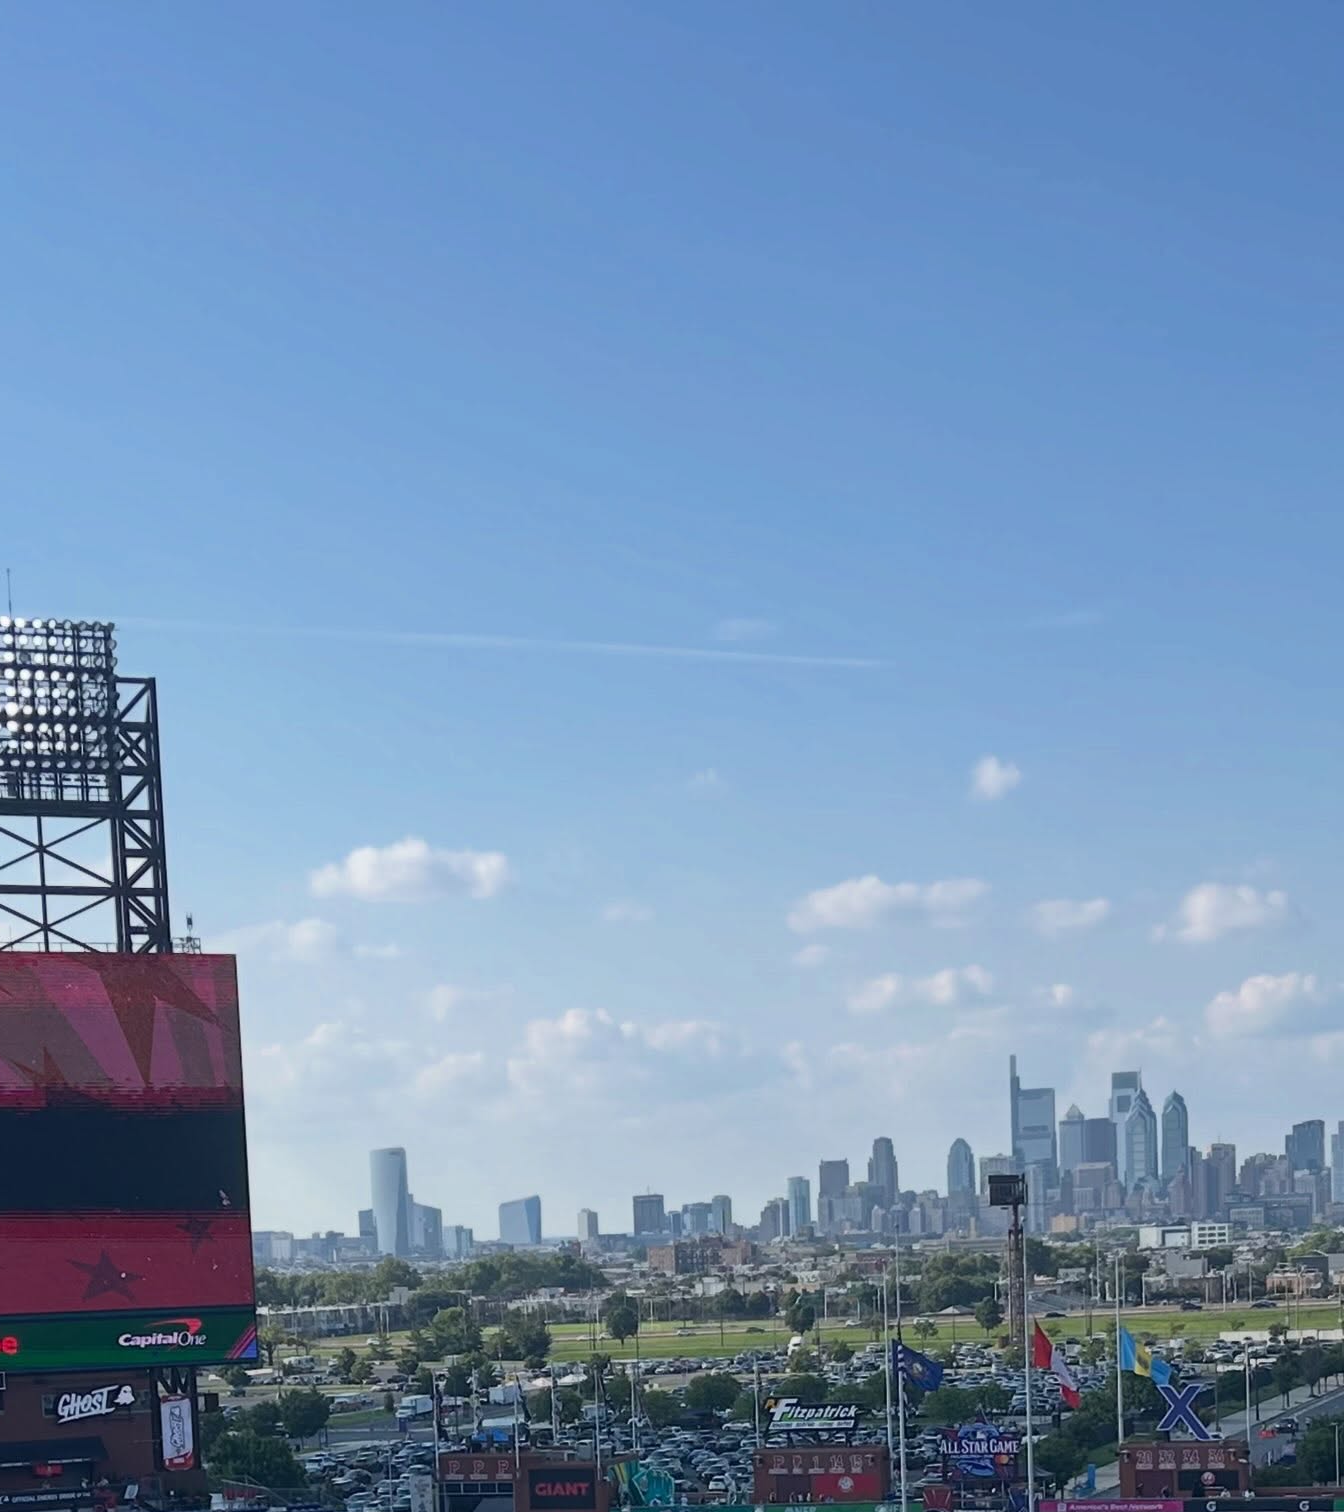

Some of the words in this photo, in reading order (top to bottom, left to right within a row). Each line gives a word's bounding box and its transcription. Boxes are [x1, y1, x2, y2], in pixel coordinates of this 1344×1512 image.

[57, 1385, 119, 1424] GHOST
[769, 1398, 859, 1422] Fitzpatrick
[940, 1440, 960, 1454] ALL
[961, 1440, 988, 1454] STAR
[990, 1439, 1019, 1454] GAME
[536, 1483, 590, 1497] GIANT
[1206, 1501, 1216, 1512] G
